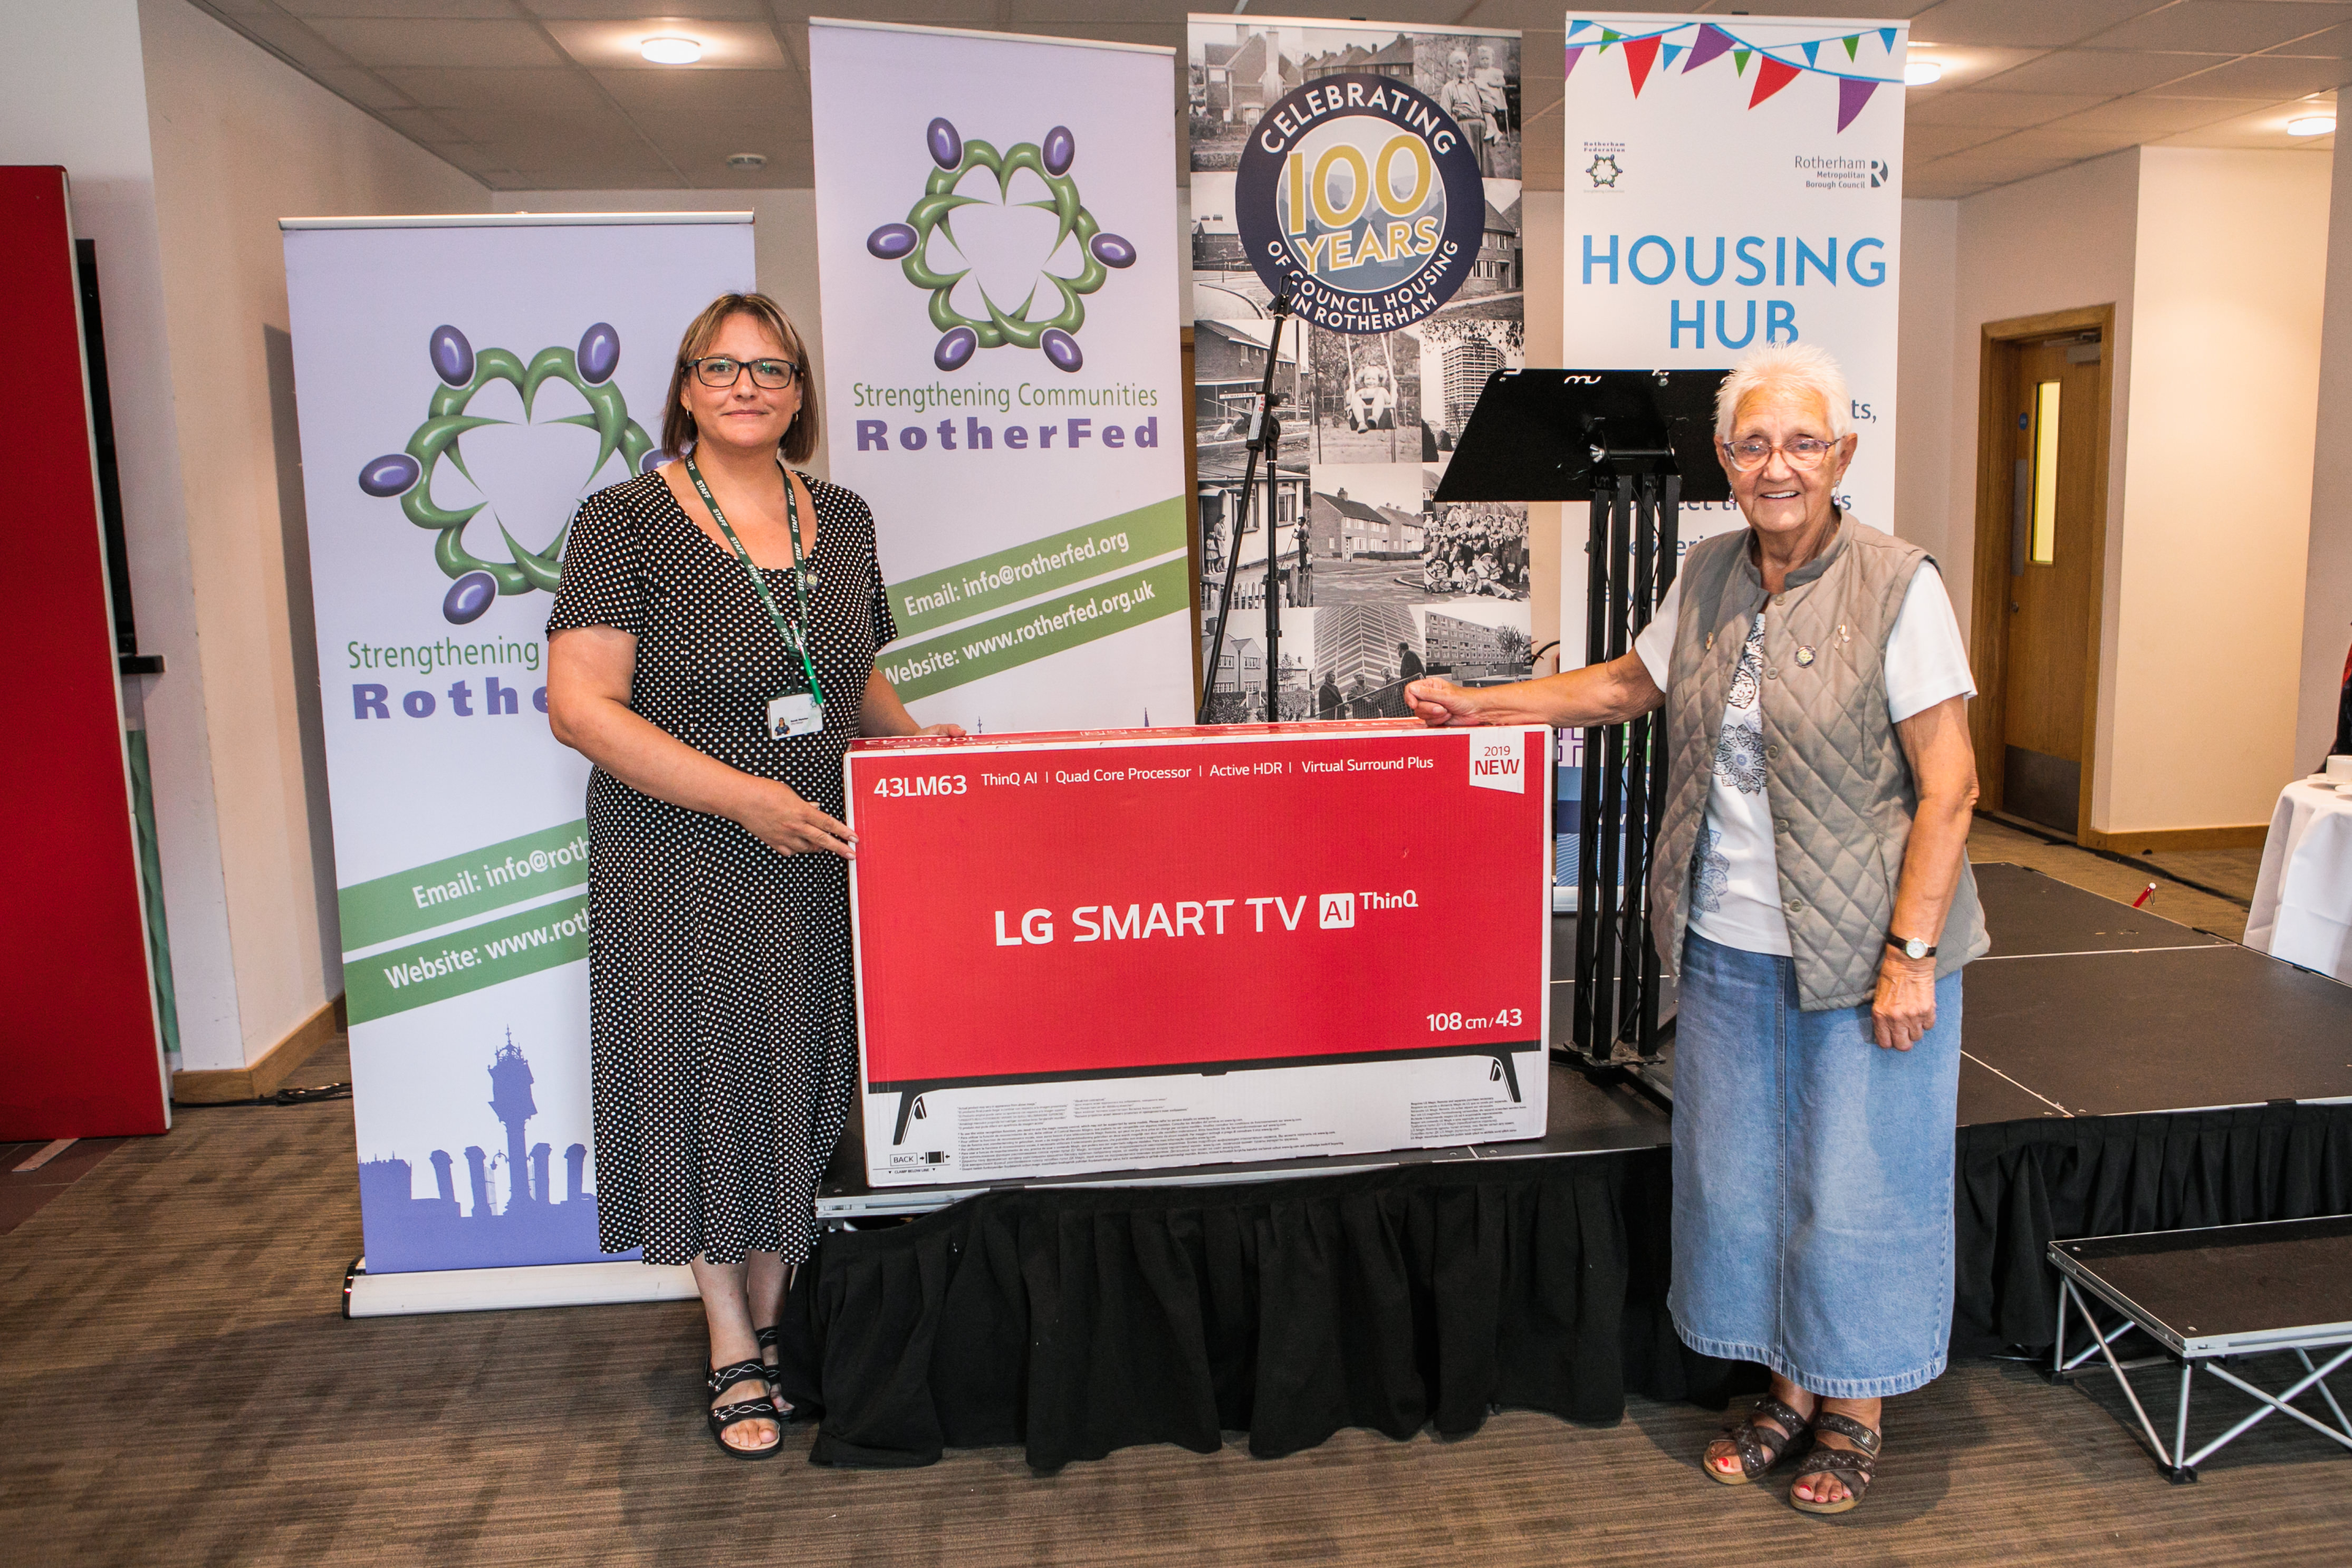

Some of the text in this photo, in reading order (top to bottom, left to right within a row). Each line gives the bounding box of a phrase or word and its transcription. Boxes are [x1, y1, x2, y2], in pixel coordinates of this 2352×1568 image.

[1261, 83, 1457, 155] CELEBRATING
[1795, 155, 1865, 169] Rotherham
[1817, 171, 1865, 179] Metropolitan
[1287, 131, 1433, 235] 100
[1806, 180, 1836, 189] Borough
[1295, 216, 1438, 275] YEARS
[1582, 235, 1885, 287] HOUSING
[1268, 240, 1458, 313] OF COUNCIL HOUSING
[1290, 292, 1437, 331] IN ROTHERHAM
[1671, 300, 1799, 349] HUB
[853, 381, 1158, 412] Strengthening Communities
[856, 416, 1158, 451] RotherFed
[696, 480, 711, 499] STAFF
[713, 508, 728, 527] STAFF
[731, 536, 746, 555] STAFF
[748, 564, 763, 584] STAFF
[904, 530, 1129, 617] Email: info@rotherfed.org
[764, 595, 780, 616] STAFF
[879, 580, 1156, 685] Website: www.rotherfed.org.uk
[348, 636, 540, 675] Strengthening
[1475, 758, 1520, 775] NEW
[1484, 745, 1511, 757] 2019
[874, 756, 1434, 797] 43LM63 ThinQ AI Quad Core Processor Active HDR Virtual Surround Plus
[412, 870, 482, 909] Email:
[994, 889, 1419, 947] LG SMART TV AI ThinQ
[383, 947, 482, 989] Website:
[1426, 1012, 1462, 1032] 108
